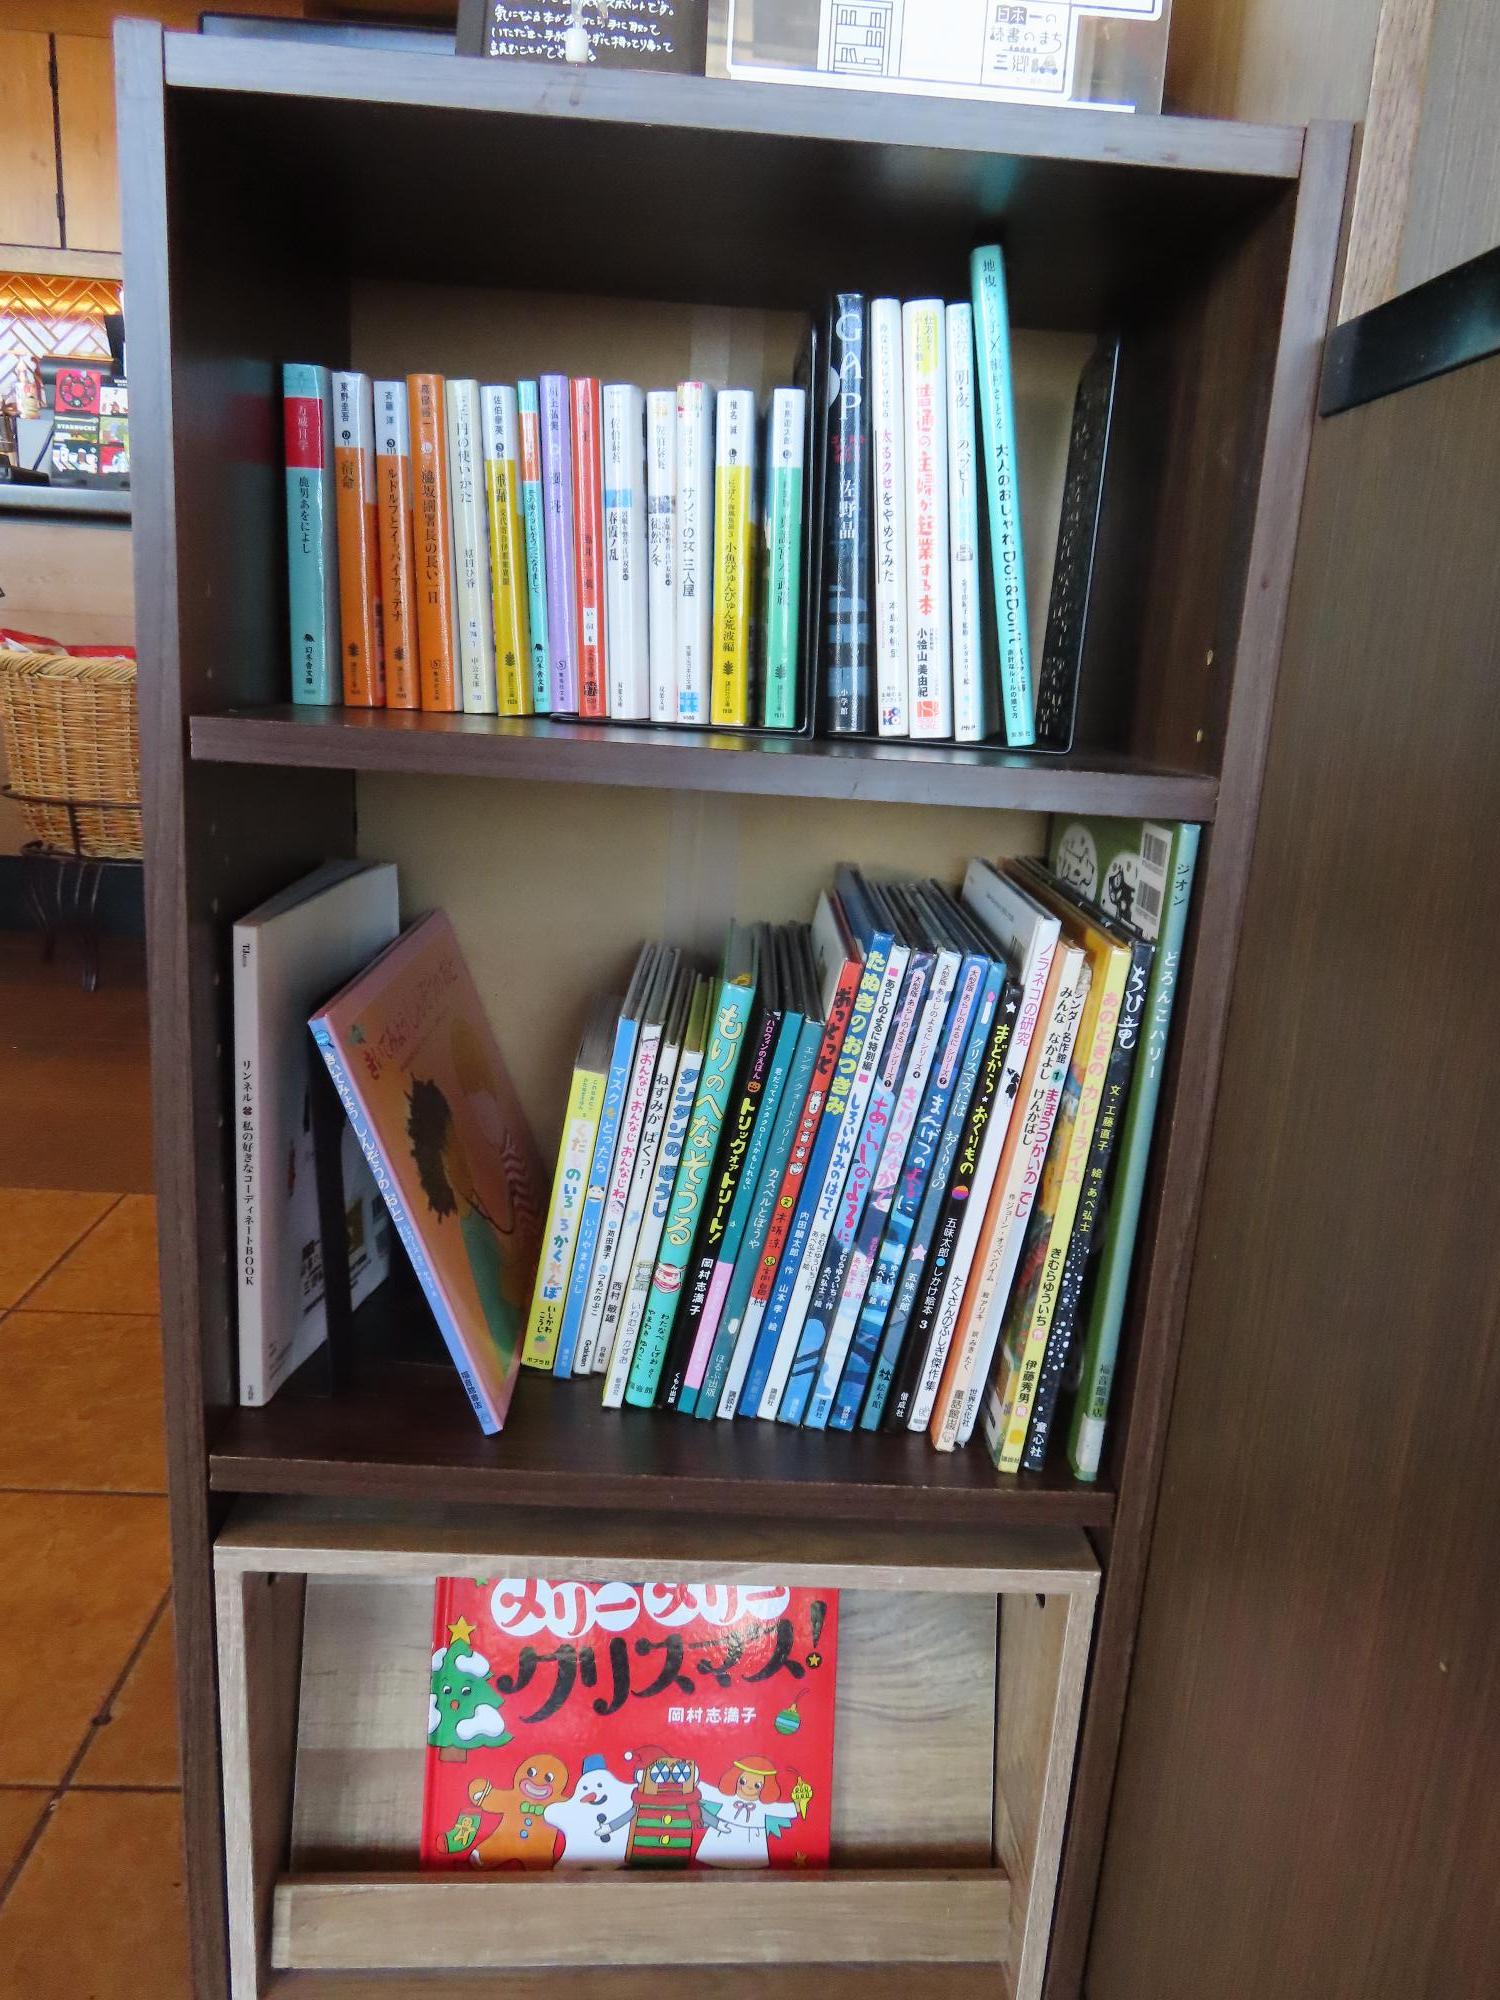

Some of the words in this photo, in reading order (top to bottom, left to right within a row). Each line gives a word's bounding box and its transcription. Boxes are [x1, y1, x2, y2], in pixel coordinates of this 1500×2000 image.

[836, 313, 863, 409] GAP
[299, 476, 312, 554] 鹿男あをによし
[839, 478, 855, 540] 佐野晶
[916, 383, 934, 616] 普通の主婦が起業する本
[995, 444, 1015, 546] 大人のおしゃれ
[682, 558, 696, 598] 三人屋
[722, 542, 738, 653] 小魚びゅんびゅん荒波編
[839, 688, 849, 716] 小学館
[1172, 864, 1190, 906] ジオン
[861, 979, 896, 1071] あらしのよるに特別編
[1016, 944, 1053, 1047] ノラネコの研究
[1054, 986, 1076, 1025] みんな
[1117, 964, 1145, 1050] ちび竜
[1148, 951, 1181, 1079] どろんこハリー
[752, 1018, 775, 1080] ハロウィンのえほん
[825, 950, 888, 1116] たぬきのおつきみ
[985, 1023, 1010, 1094] まどから
[1038, 1032, 1061, 1080] なかよし
[1087, 991, 1119, 1077] あのときの
[242, 1060, 251, 1102] リンネル
[607, 1066, 627, 1105] マスク
[647, 1074, 669, 1125] ねずみが
[951, 1037, 982, 1117] クリスマスには
[664, 1068, 700, 1158] タンタンの
[666, 1003, 743, 1246] もりのへなそうる
[959, 1105, 988, 1175] おくりもの
[1022, 1088, 1046, 1146] けんかばし
[1023, 1088, 1059, 1185] まほうつかいの
[1065, 1087, 1100, 1184] カレーライス
[1097, 1084, 1121, 1151] 文・工藤直子
[595, 1123, 614, 1173] とったら
[819, 1093, 862, 1221] しろいやみのはてで
[931, 1131, 959, 1190] おくりもの
[748, 1168, 780, 1249] カスペルとぼうや
[1080, 1166, 1103, 1233] 絵・あべ弘士
[937, 1217, 958, 1258] 五味太郎
[689, 1257, 714, 1316] 岡村志満子
[923, 1267, 943, 1316] しかけ絵本
[537, 1311, 546, 1333] こうじ
[544, 1305, 556, 1333] いしかわ
[924, 1275, 964, 1392] たくさんのふしぎ傑作集
[580, 1339, 592, 1368] Gakken
[1016, 1359, 1038, 1404] 伊藤秀男
[667, 1372, 681, 1404] くもん出版
[871, 1384, 885, 1409] 絵本館
[895, 1391, 910, 1418] 偕成社
[960, 1388, 978, 1427] 世界文化社
[1029, 1420, 1048, 1458] 童心社
[496, 1600, 828, 1724] クリスマス!
[667, 1705, 758, 1726] 岡村志満子
